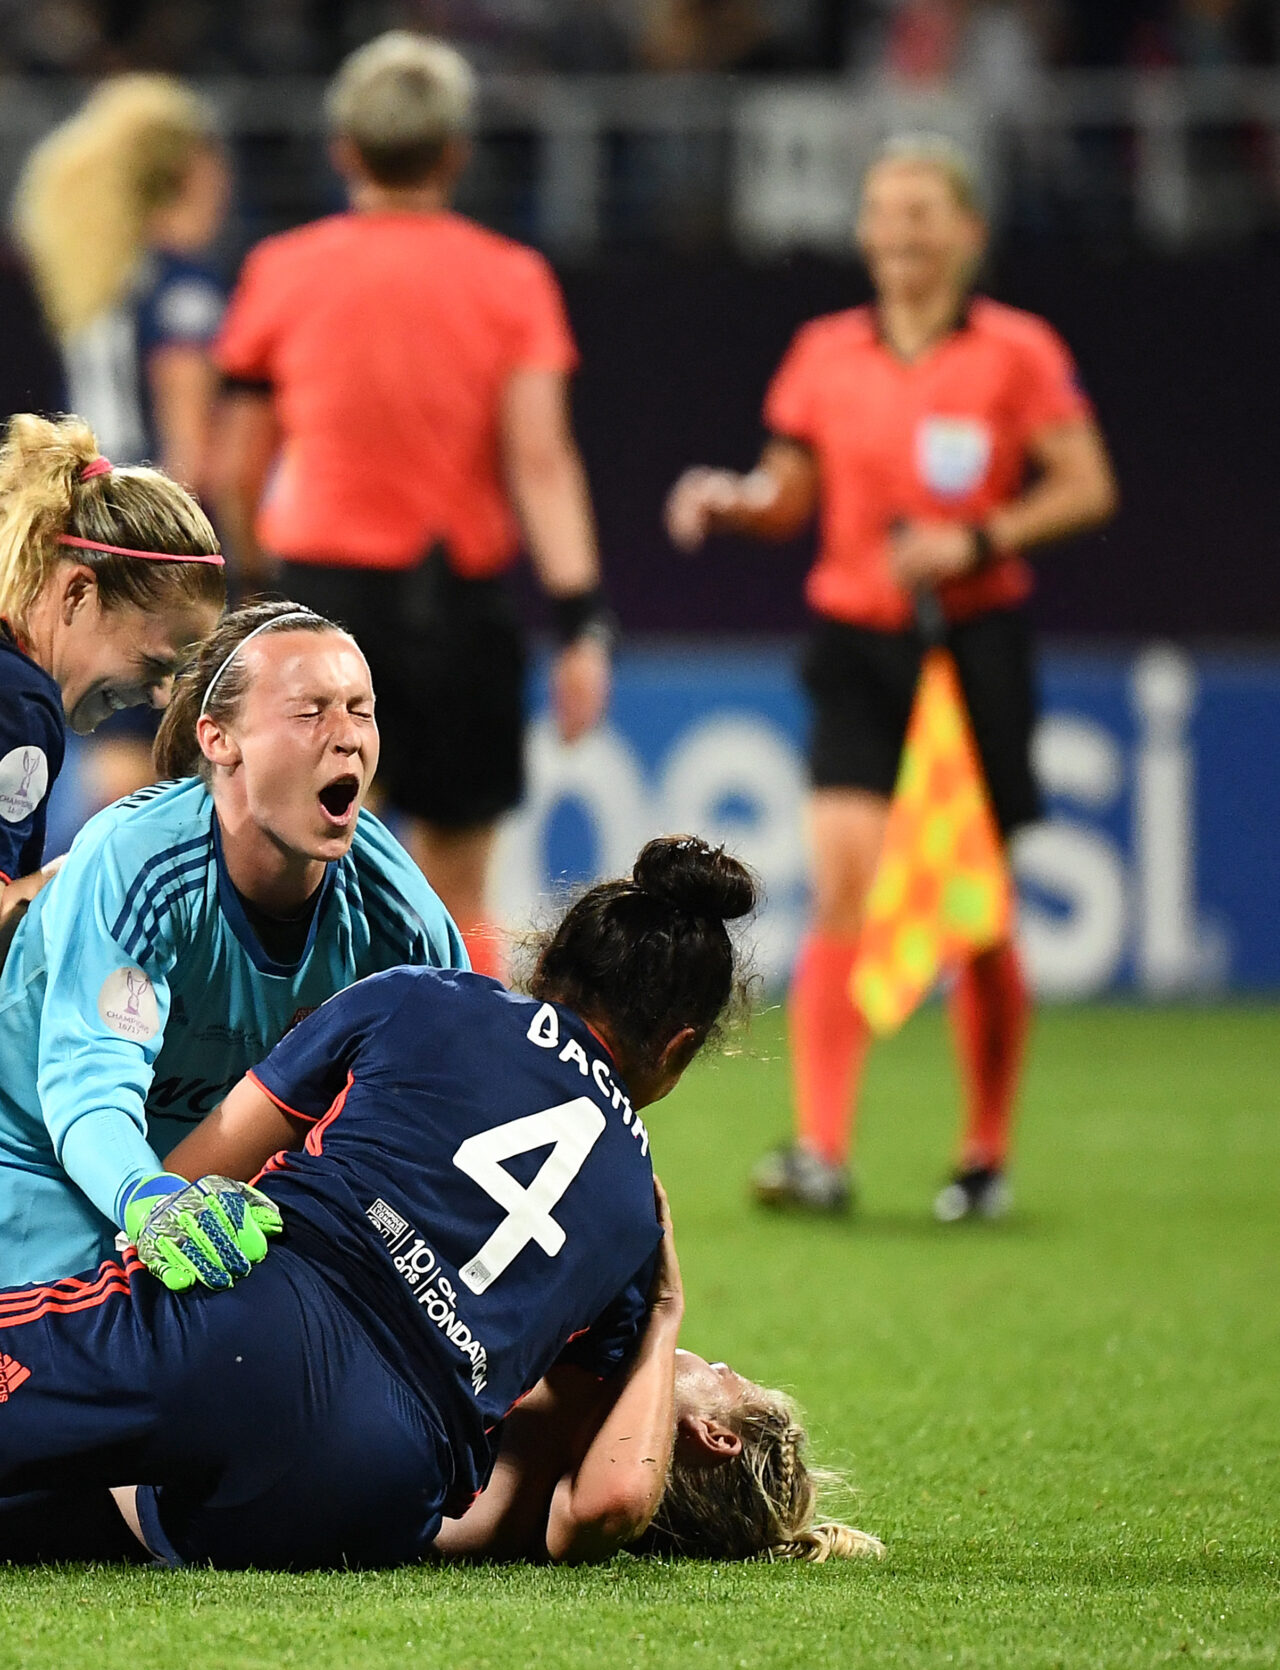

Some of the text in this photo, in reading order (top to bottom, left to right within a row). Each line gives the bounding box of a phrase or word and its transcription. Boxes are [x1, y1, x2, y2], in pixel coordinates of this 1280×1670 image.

[482, 642, 1196, 1002] pesi
[453, 1096, 606, 1295] 4
[393, 1256, 420, 1284] ans
[403, 1239, 435, 1274] 10
[438, 1277, 457, 1308] OL
[418, 1288, 487, 1396] FONDATION
